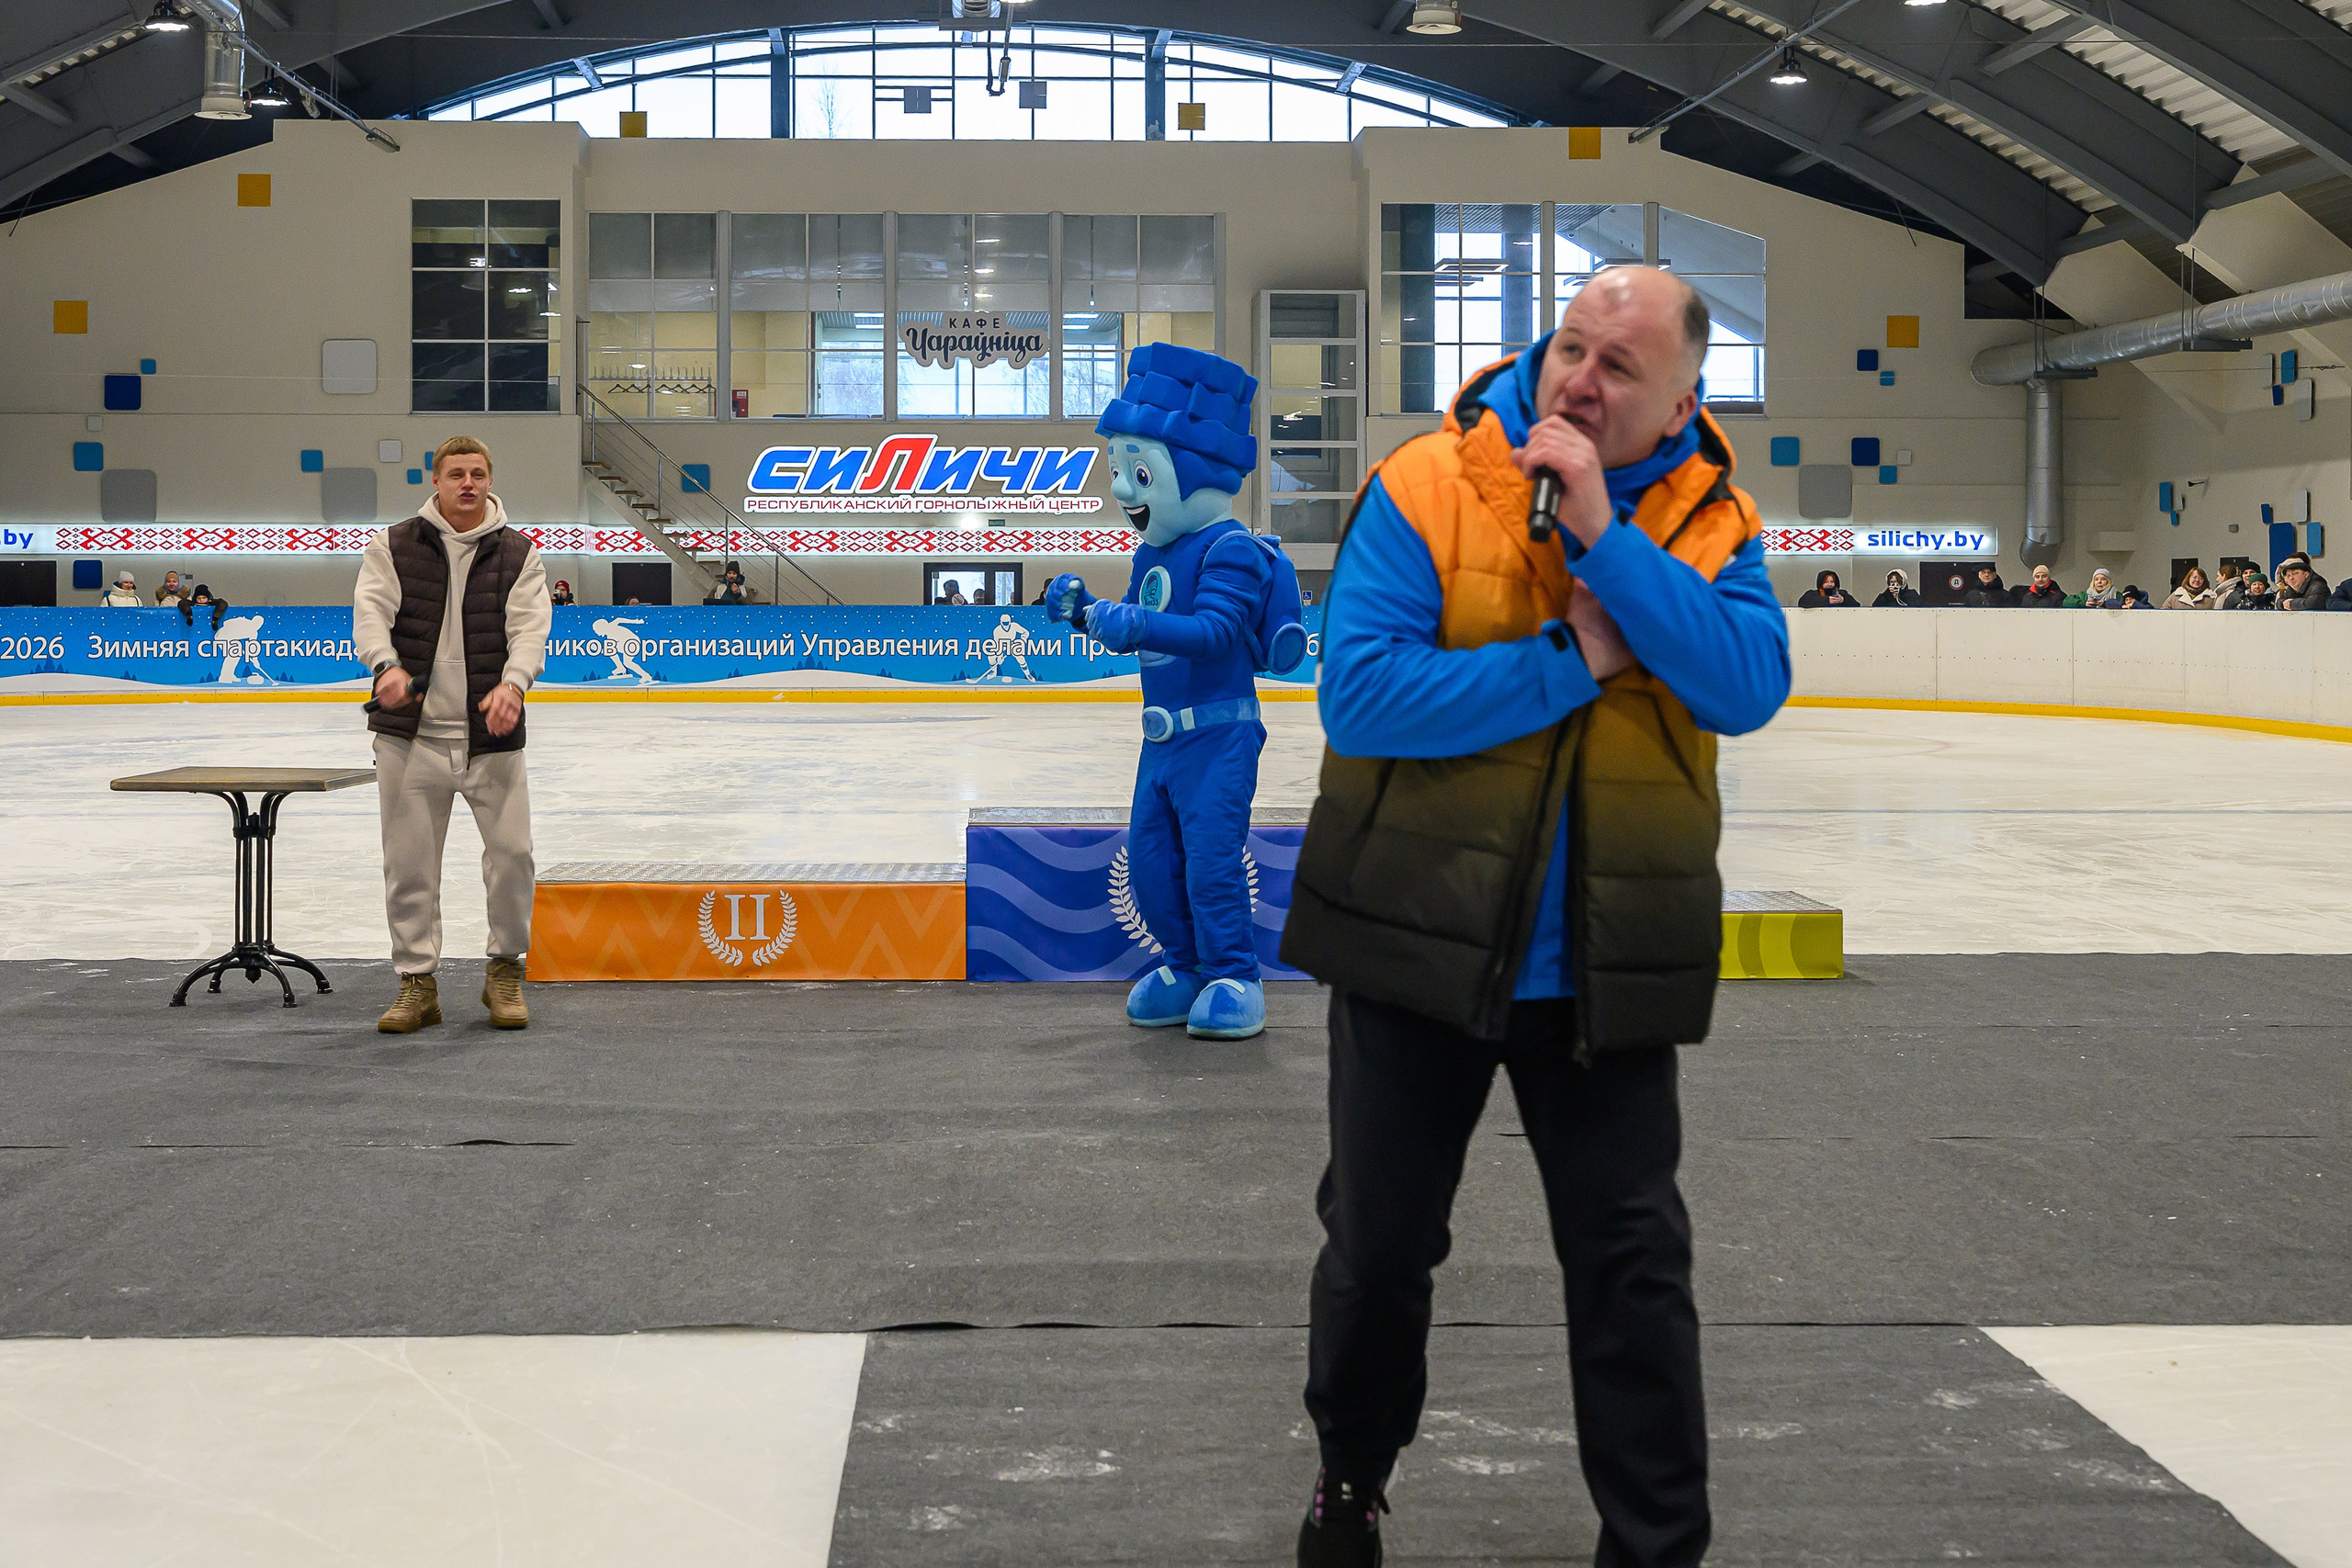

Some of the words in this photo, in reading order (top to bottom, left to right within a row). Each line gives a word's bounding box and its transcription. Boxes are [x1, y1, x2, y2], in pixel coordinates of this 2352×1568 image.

[949, 318, 1001, 329] КАФЕ
[906, 327, 1044, 363] Чараўніца
[747, 498, 911, 511] РЕСПУБЛИКАНСКИЙ
[915, 498, 1044, 511] ГОРНОЛЫЖНЫЙ
[1048, 500, 1100, 513] ЦЕНТР
[0, 529, 33, 549] by
[1868, 531, 1984, 550] silichy.by
[0, 636, 65, 660] 2026
[86, 635, 190, 659] Зимняя
[623, 633, 795, 662] организаций
[801, 633, 958, 661] Управления
[965, 637, 1061, 660] делами
